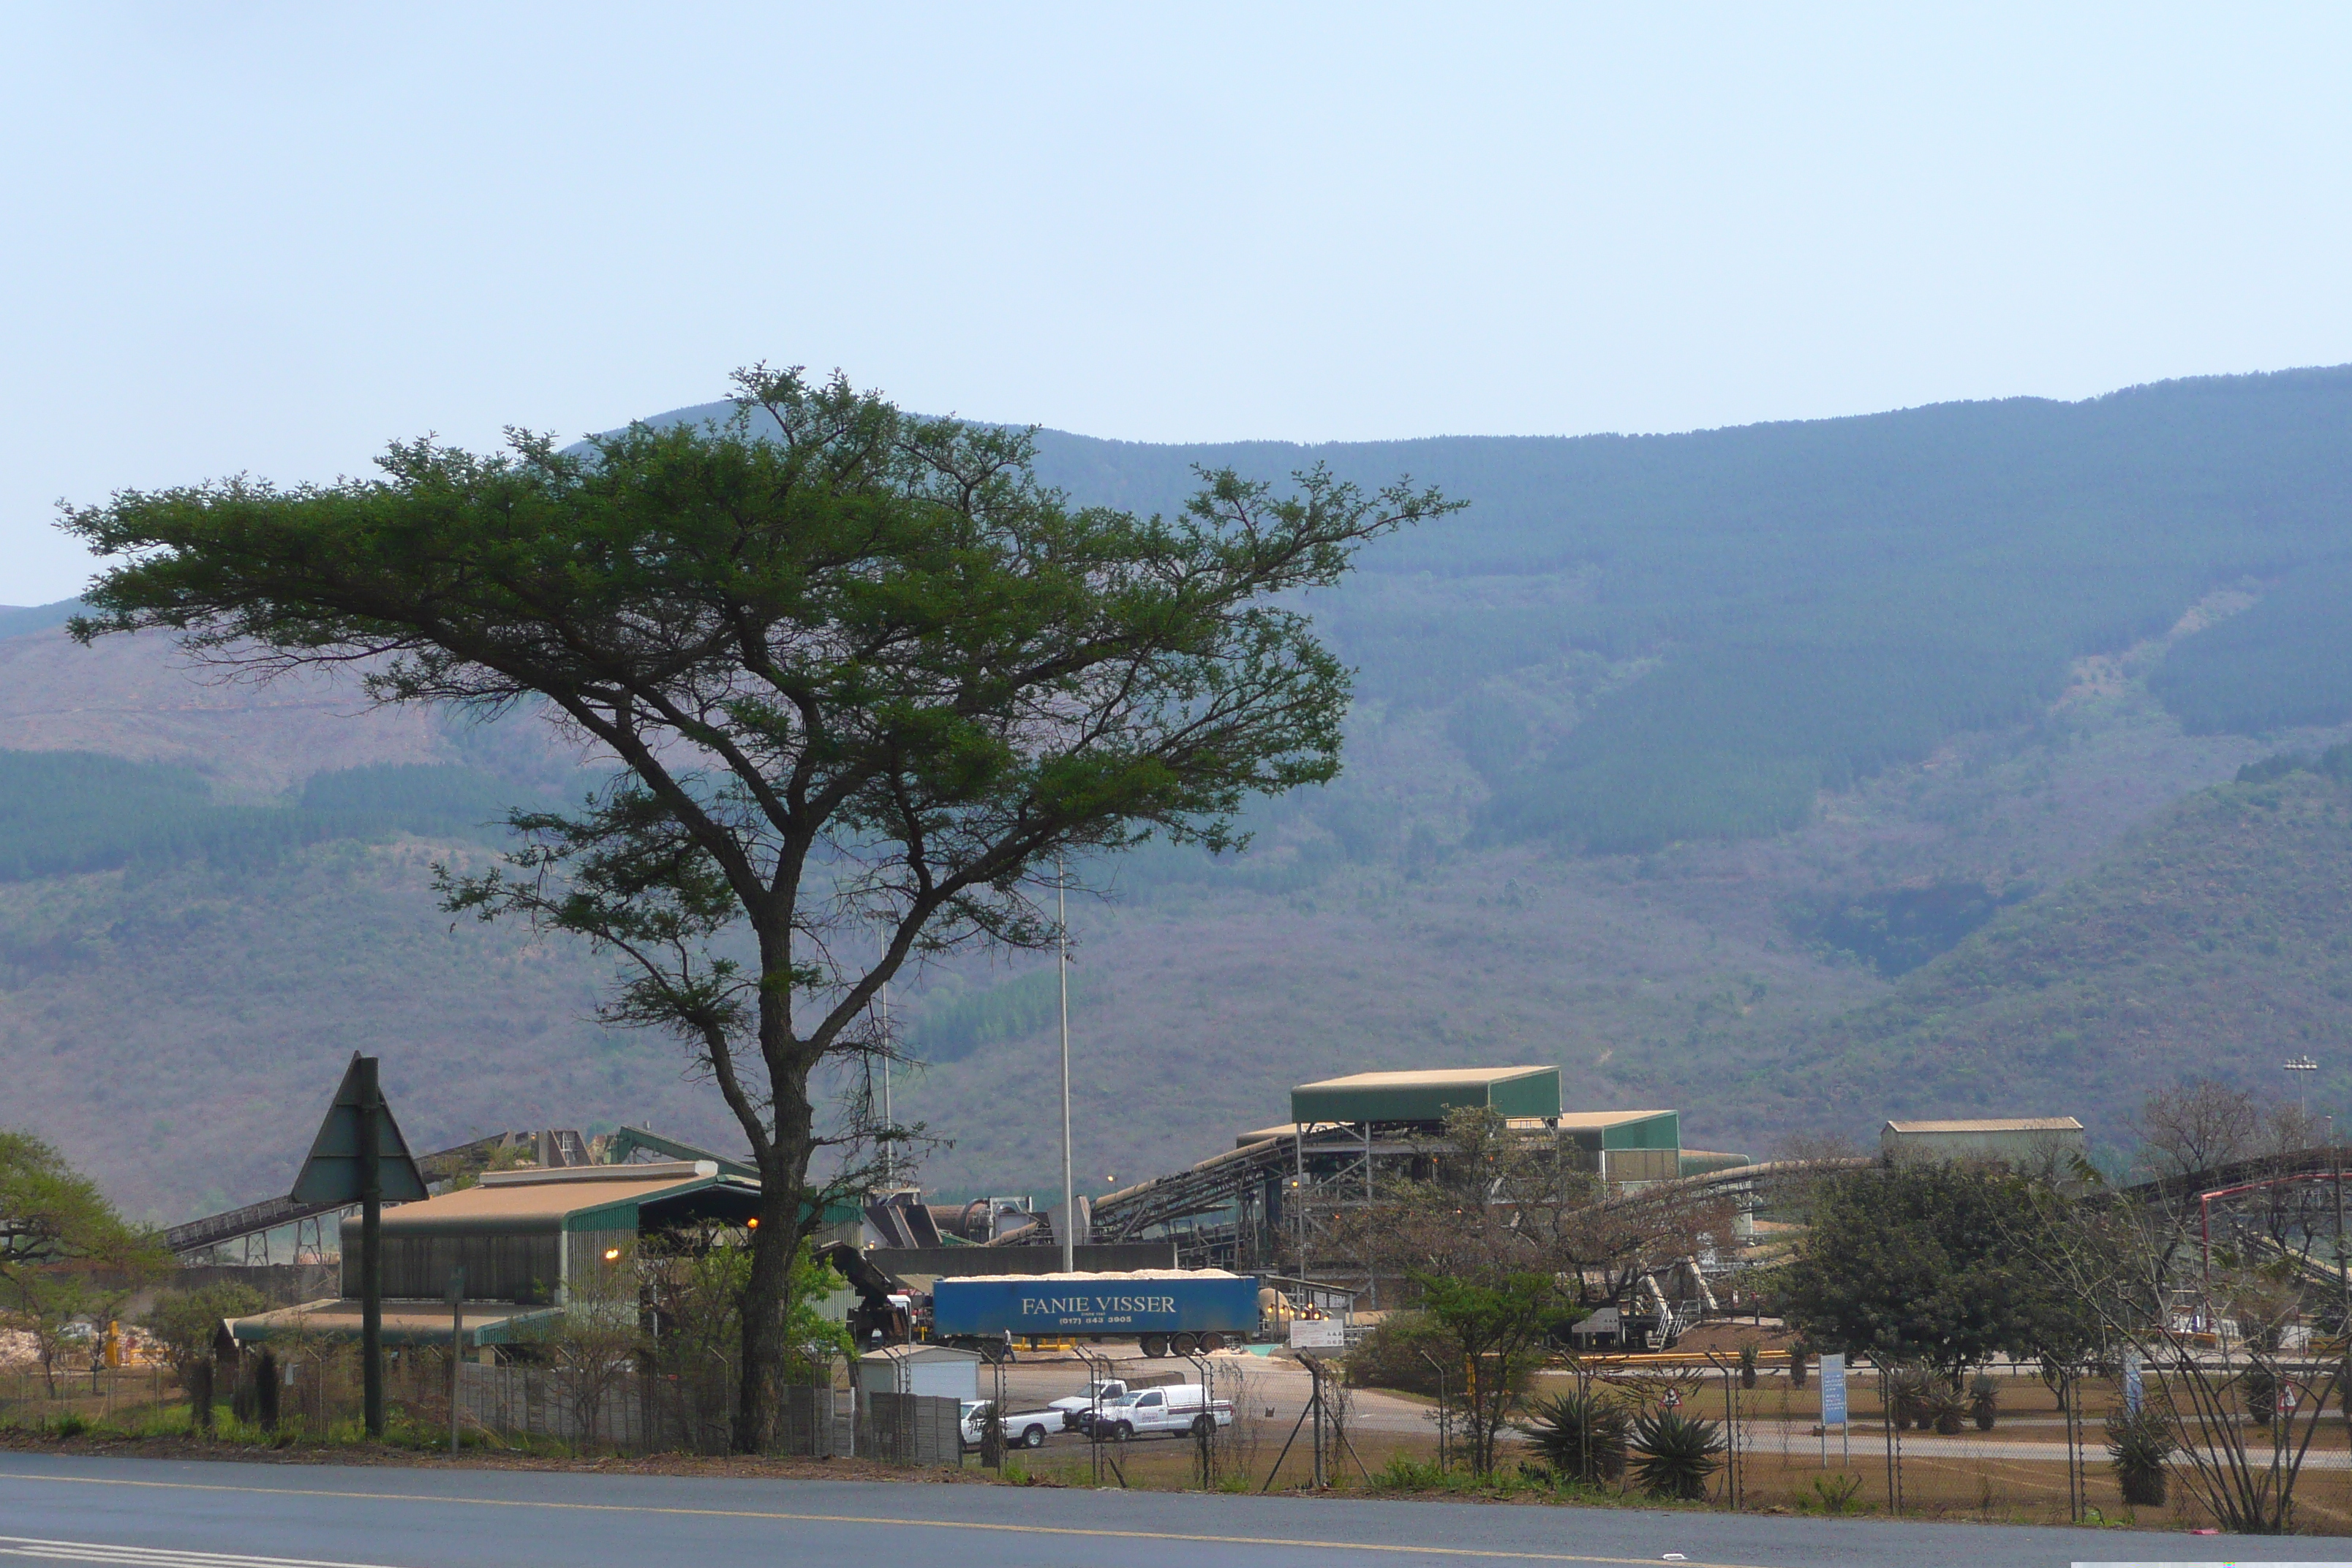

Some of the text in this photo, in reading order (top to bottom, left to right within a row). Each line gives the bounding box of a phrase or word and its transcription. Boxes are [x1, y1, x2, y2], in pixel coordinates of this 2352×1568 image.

[1022, 1297, 1176, 1314] FANIE VISSER
[1059, 1317, 1082, 1325] (017)
